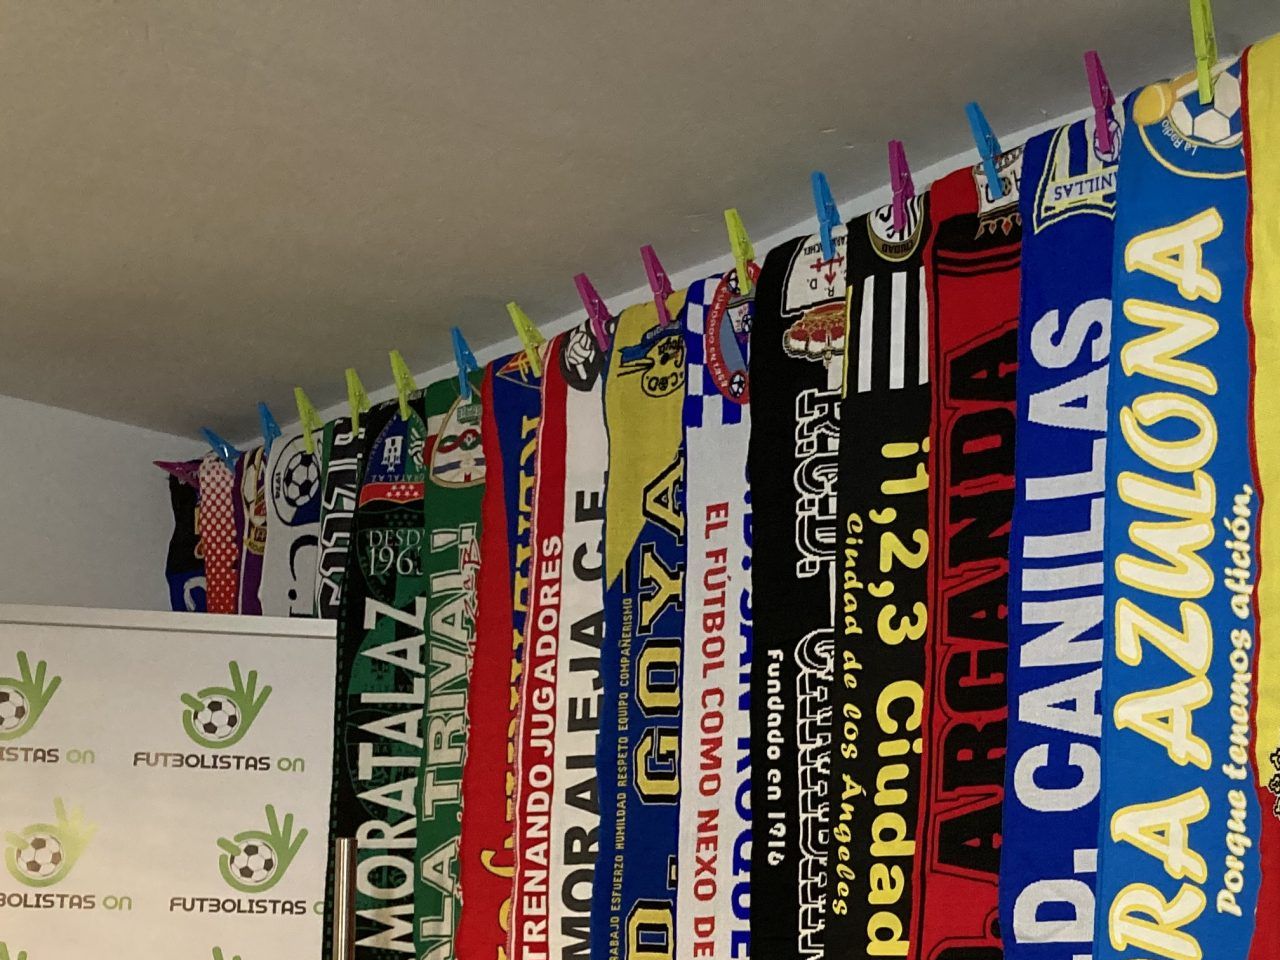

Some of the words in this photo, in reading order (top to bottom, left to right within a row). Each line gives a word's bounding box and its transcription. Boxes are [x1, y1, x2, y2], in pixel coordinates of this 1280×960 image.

[703, 501, 730, 541] EL
[1112, 206, 1225, 771] AZULONA
[930, 317, 1020, 886] ARGANDA
[1013, 297, 1114, 814] CANILLAS
[528, 534, 562, 757] JUGADORES
[632, 447, 689, 806] GOYA
[701, 547, 732, 679] FÚTBOL
[618, 692, 630, 731] EQUIPO
[766, 648, 786, 760] Fundado
[842, 648, 864, 690] de
[1222, 627, 1254, 782] tenemos
[617, 731, 629, 787] RESPETO
[699, 686, 725, 795] COMO
[840, 702, 863, 760] los
[615, 790, 627, 849] HUMILDAD
[766, 768, 783, 801] en
[611, 855, 624, 911] ESFUERZO
[694, 808, 720, 901] NEXO
[693, 915, 716, 959] DE
